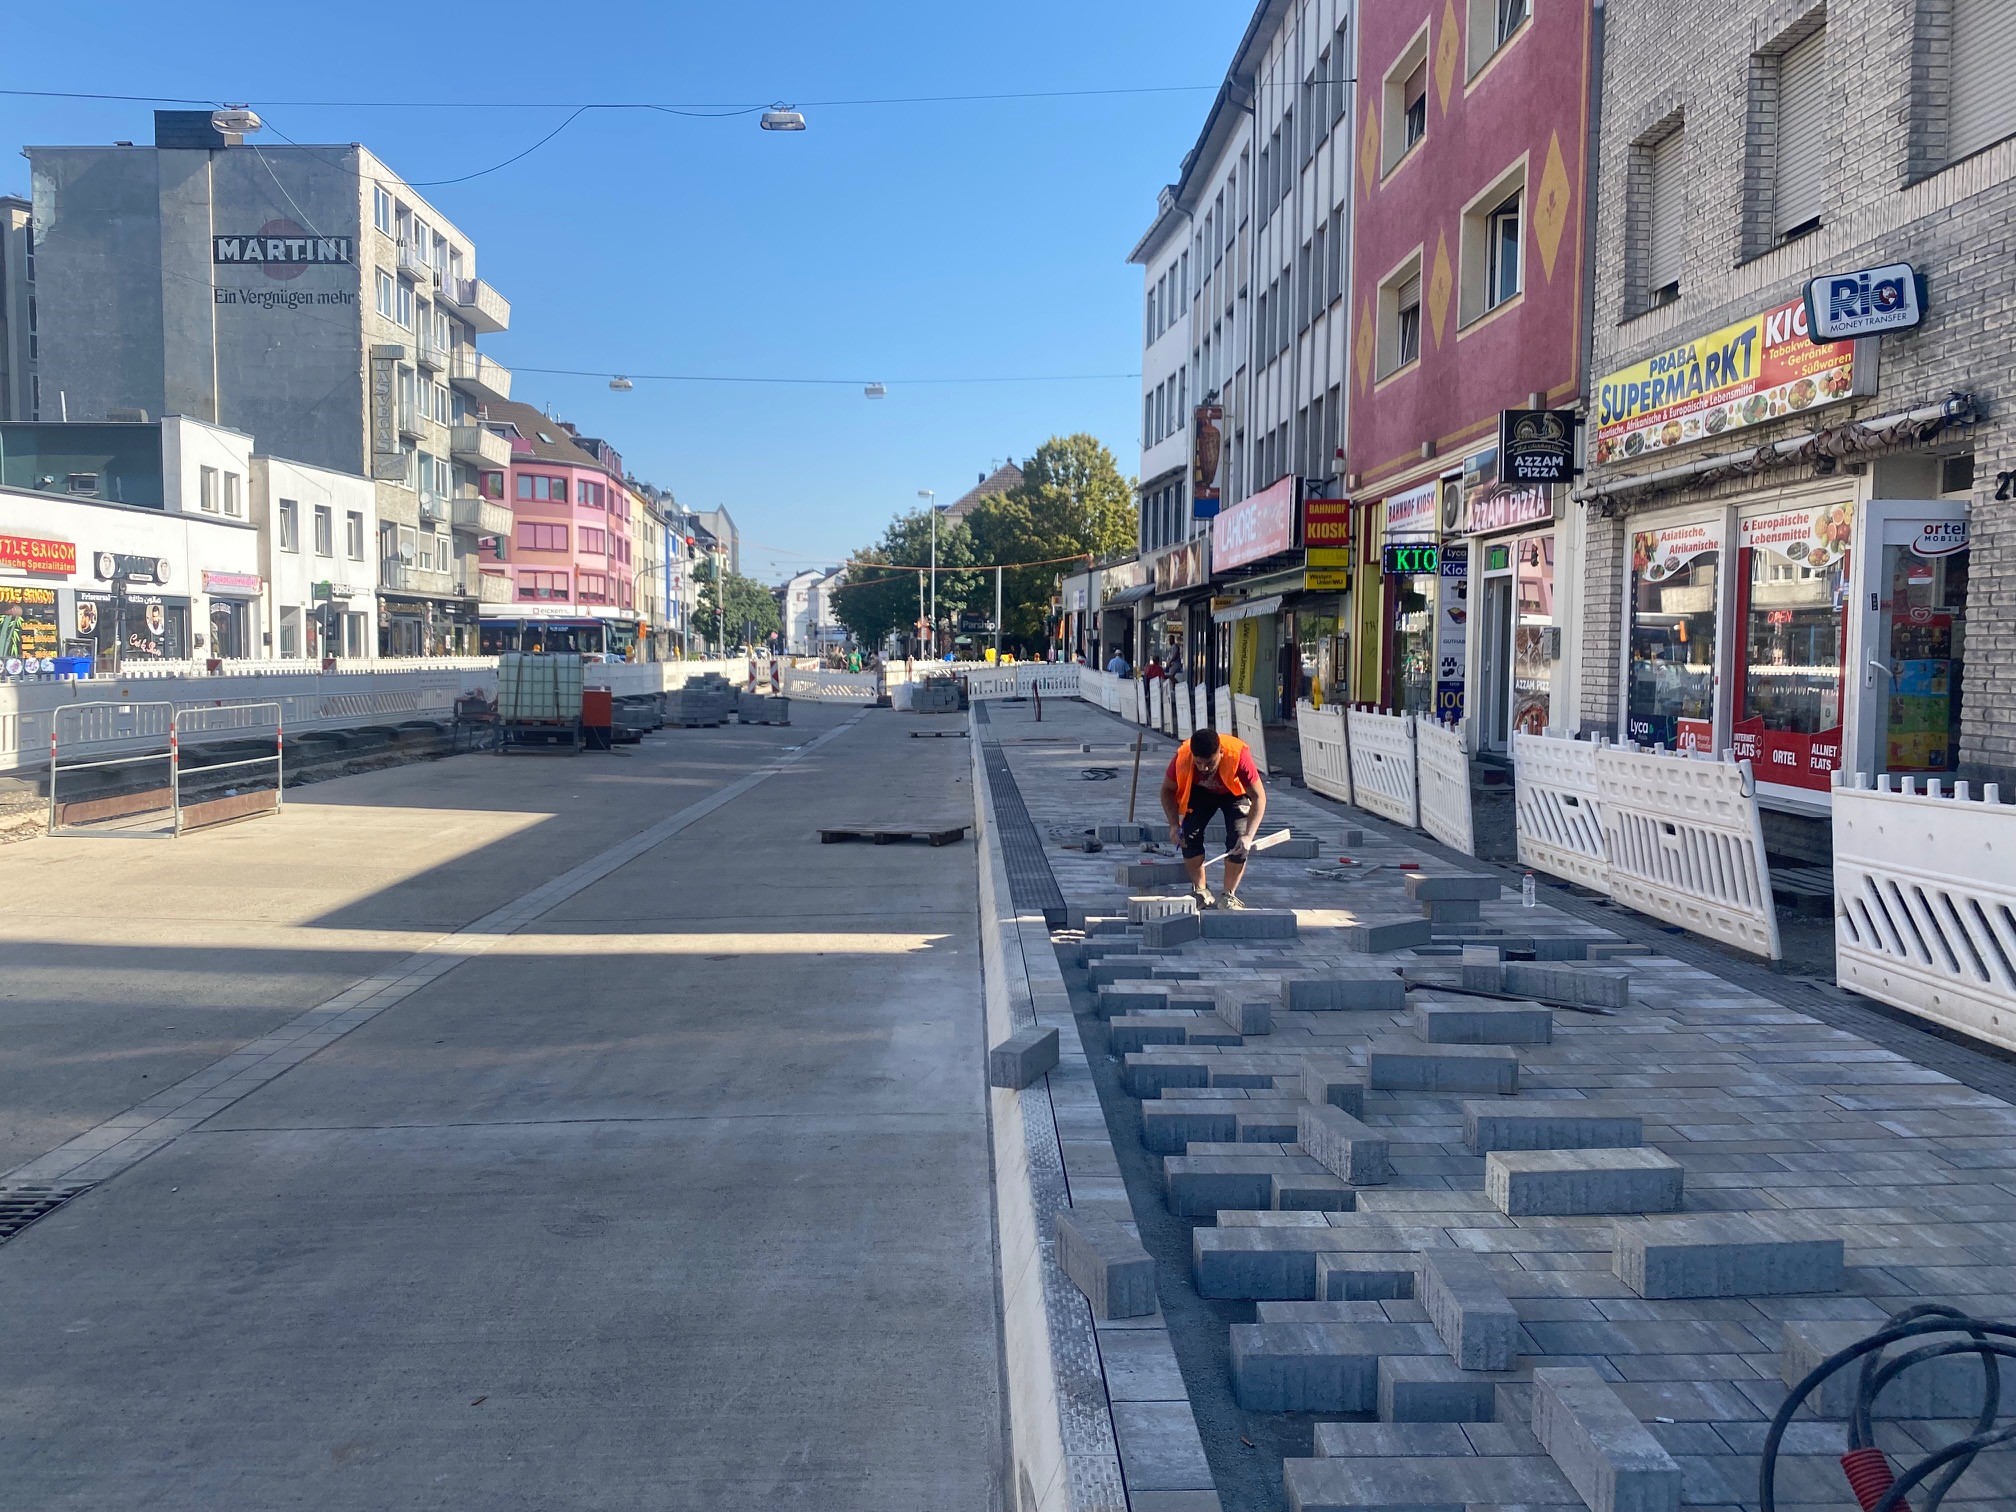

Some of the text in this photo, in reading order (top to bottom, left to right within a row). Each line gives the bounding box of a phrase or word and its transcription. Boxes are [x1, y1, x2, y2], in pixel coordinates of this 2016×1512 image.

[218, 238, 348, 261] MARTINI
[214, 289, 355, 310] Ein Vergnügen mehr
[1830, 273, 1906, 322] Ria
[1830, 312, 1907, 332] MONEY TRANSFER
[1650, 344, 1698, 378] PRABA
[1788, 344, 1833, 366] Getränke
[1801, 352, 1852, 376] Süßwaren
[1600, 326, 1757, 426] SUPERMARKT
[1626, 411, 1662, 432] Afrikanische
[1662, 409, 1668, 421] &
[1669, 396, 1708, 417] Europäische
[1709, 379, 1756, 406] Lebensmittel
[1514, 456, 1564, 467] AZZAM
[1518, 467, 1560, 478] PIZZA
[1309, 504, 1346, 514] BAHNHOF
[1389, 498, 1415, 524] BAHNHOF
[1416, 490, 1436, 515] KIOSK
[1467, 484, 1546, 533] AZZAM PIZZA
[1307, 523, 1347, 538] KIOSK
[1742, 513, 1810, 532] & Europäische
[1924, 522, 1966, 535] ortel
[1660, 527, 1706, 542] Asiatische,
[1749, 527, 1811, 545] Lebensmittel
[31, 541, 75, 561] SAIGON
[1669, 539, 1719, 555] Afrikanische
[27, 559, 76, 572] Spezialitäten
[1396, 549, 1438, 571] KIO
[1767, 610, 1793, 623] OPEN
[962, 620, 996, 631] Parship
[1516, 679, 1535, 691] AZZAM
[1630, 718, 1649, 736] Lyca
[1734, 733, 1756, 743] INTERNET
[1734, 742, 1755, 757] FLATS
[1772, 749, 1798, 766] ORTEL
[1811, 743, 1838, 757] ALLNET
[1810, 756, 1832, 771] FLATS
